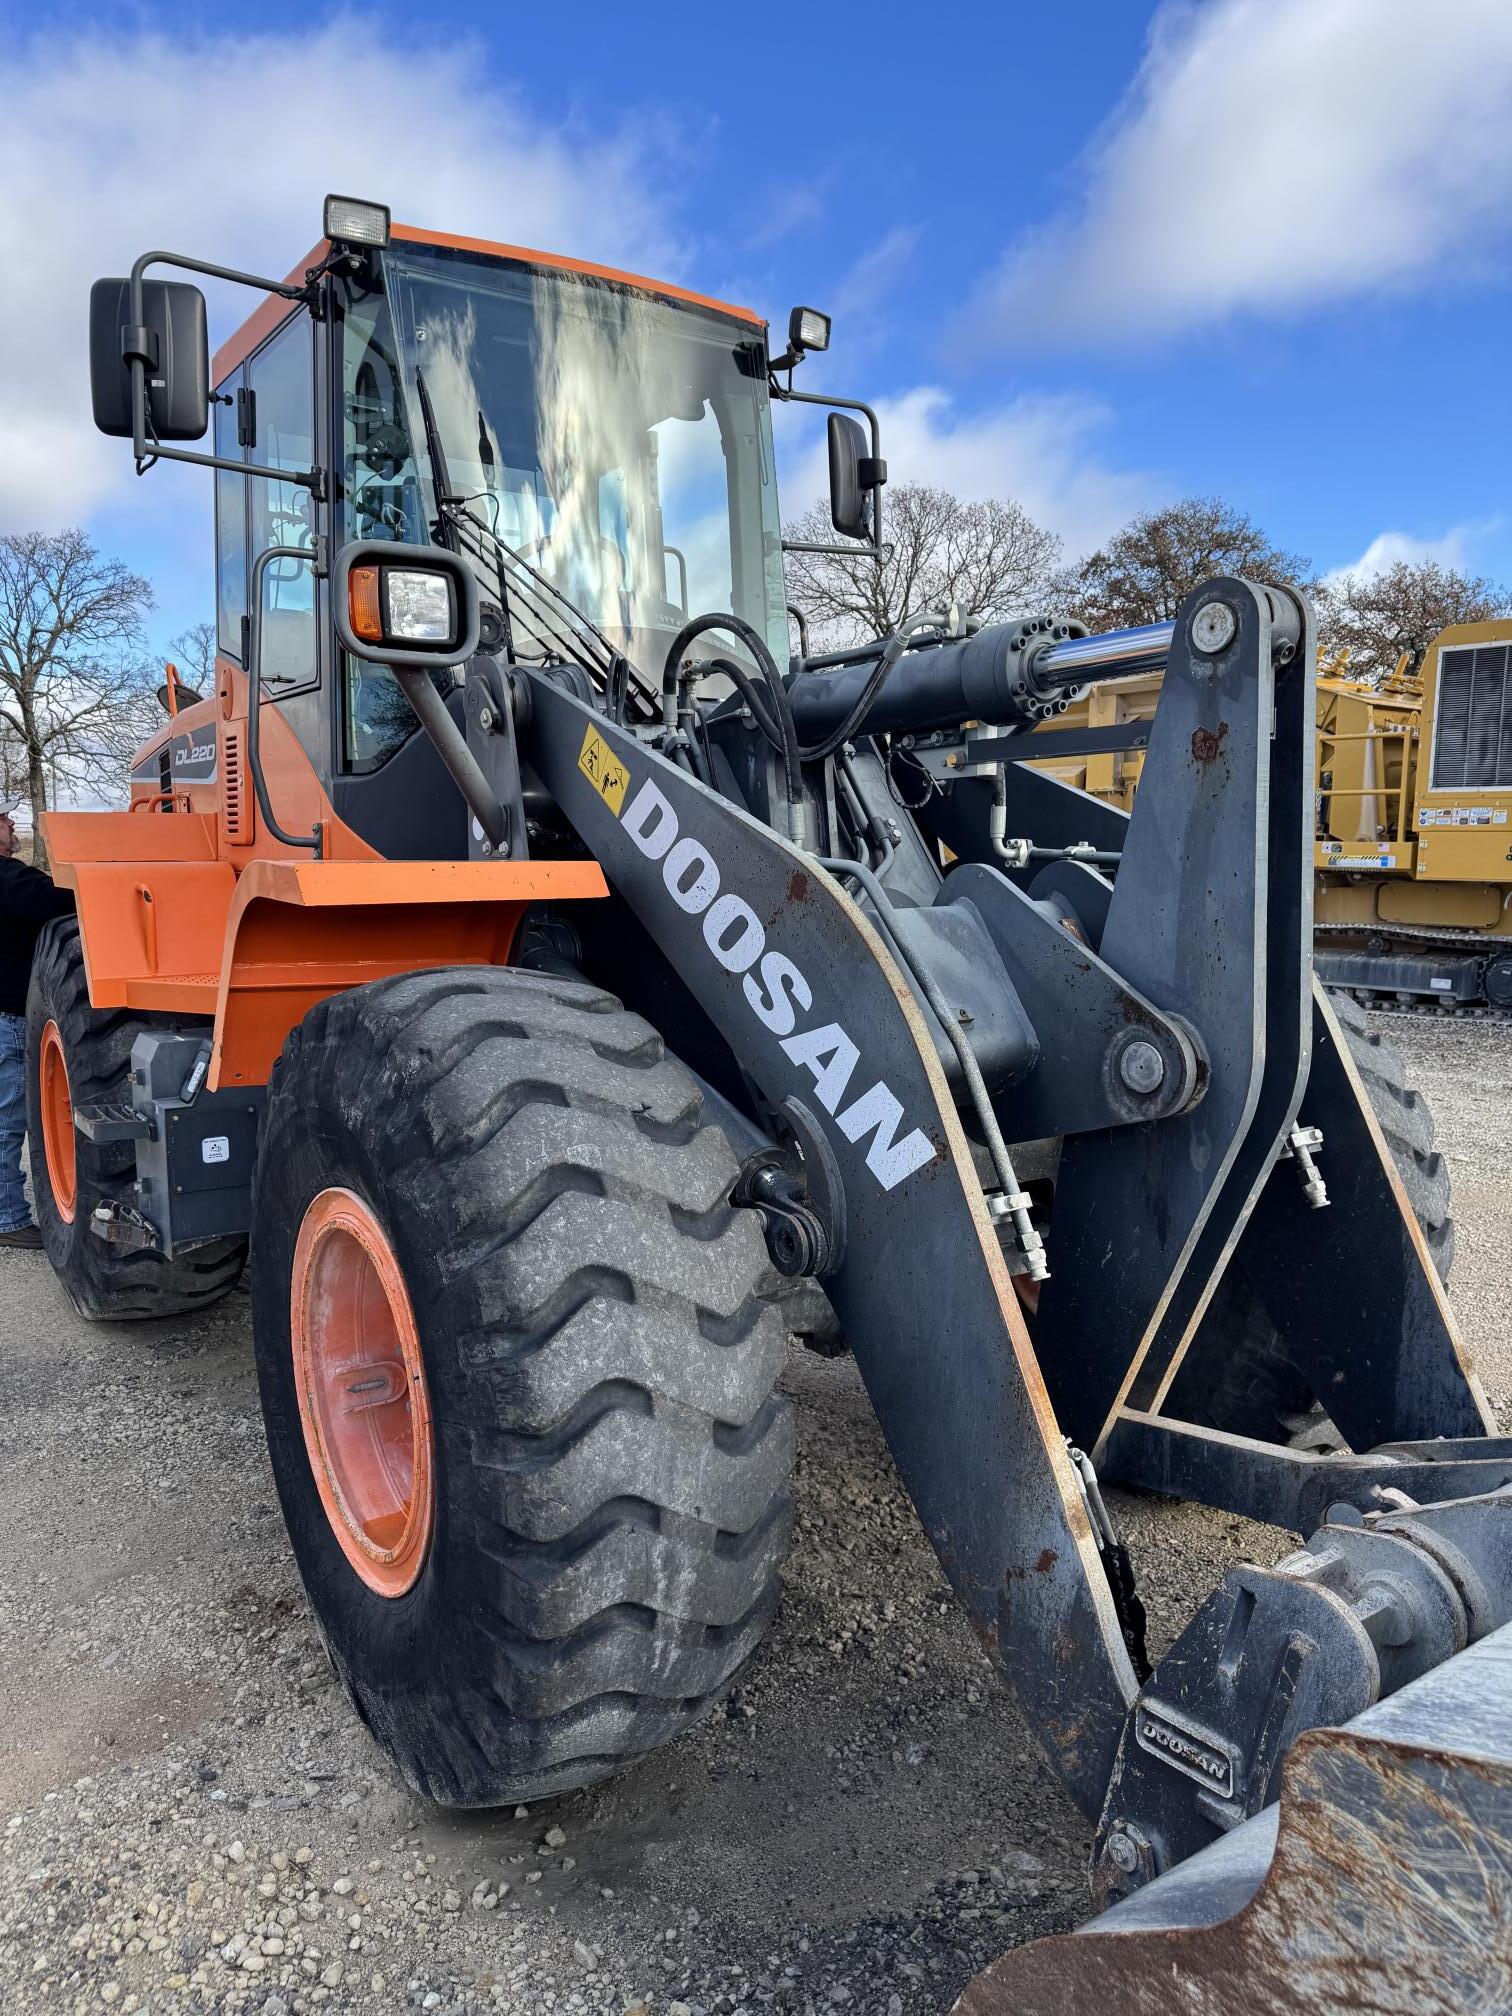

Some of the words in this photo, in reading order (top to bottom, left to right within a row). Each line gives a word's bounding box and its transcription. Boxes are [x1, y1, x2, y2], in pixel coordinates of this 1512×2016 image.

[175, 744, 216, 766] DL220
[620, 778, 938, 1191] DOOSAN
[1143, 1722, 1228, 1780] DOOSAN
